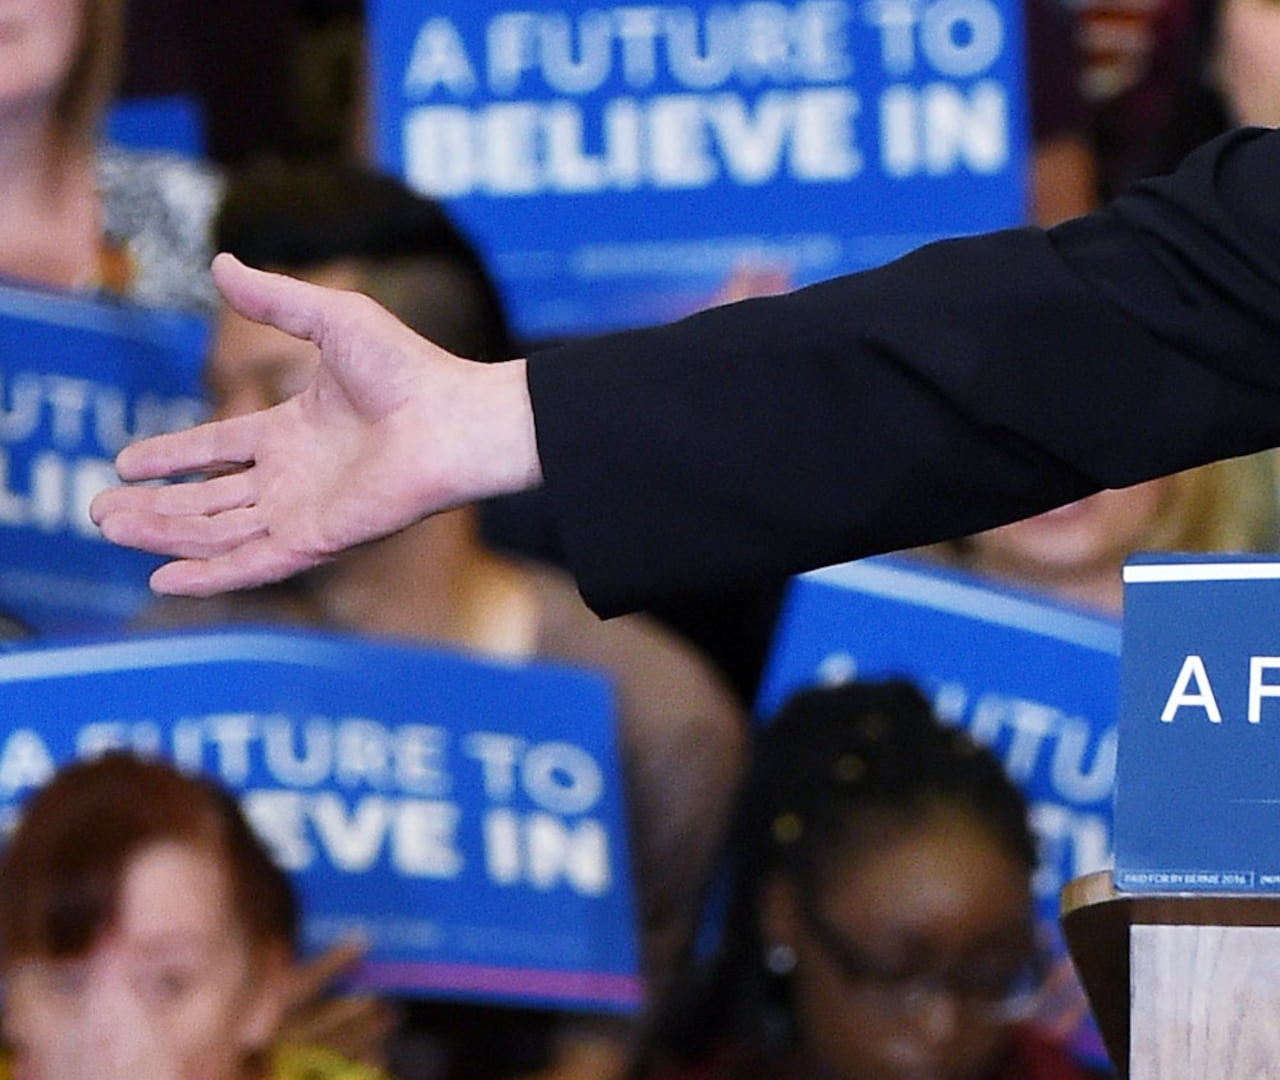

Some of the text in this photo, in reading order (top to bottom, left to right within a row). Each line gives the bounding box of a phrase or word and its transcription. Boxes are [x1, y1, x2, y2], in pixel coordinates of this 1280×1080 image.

[404, 15, 478, 99] A
[402, 78, 1010, 199] BELIEVE IN
[1160, 655, 1222, 724] A
[461, 730, 604, 816] TO
[482, 806, 612, 898] IN
